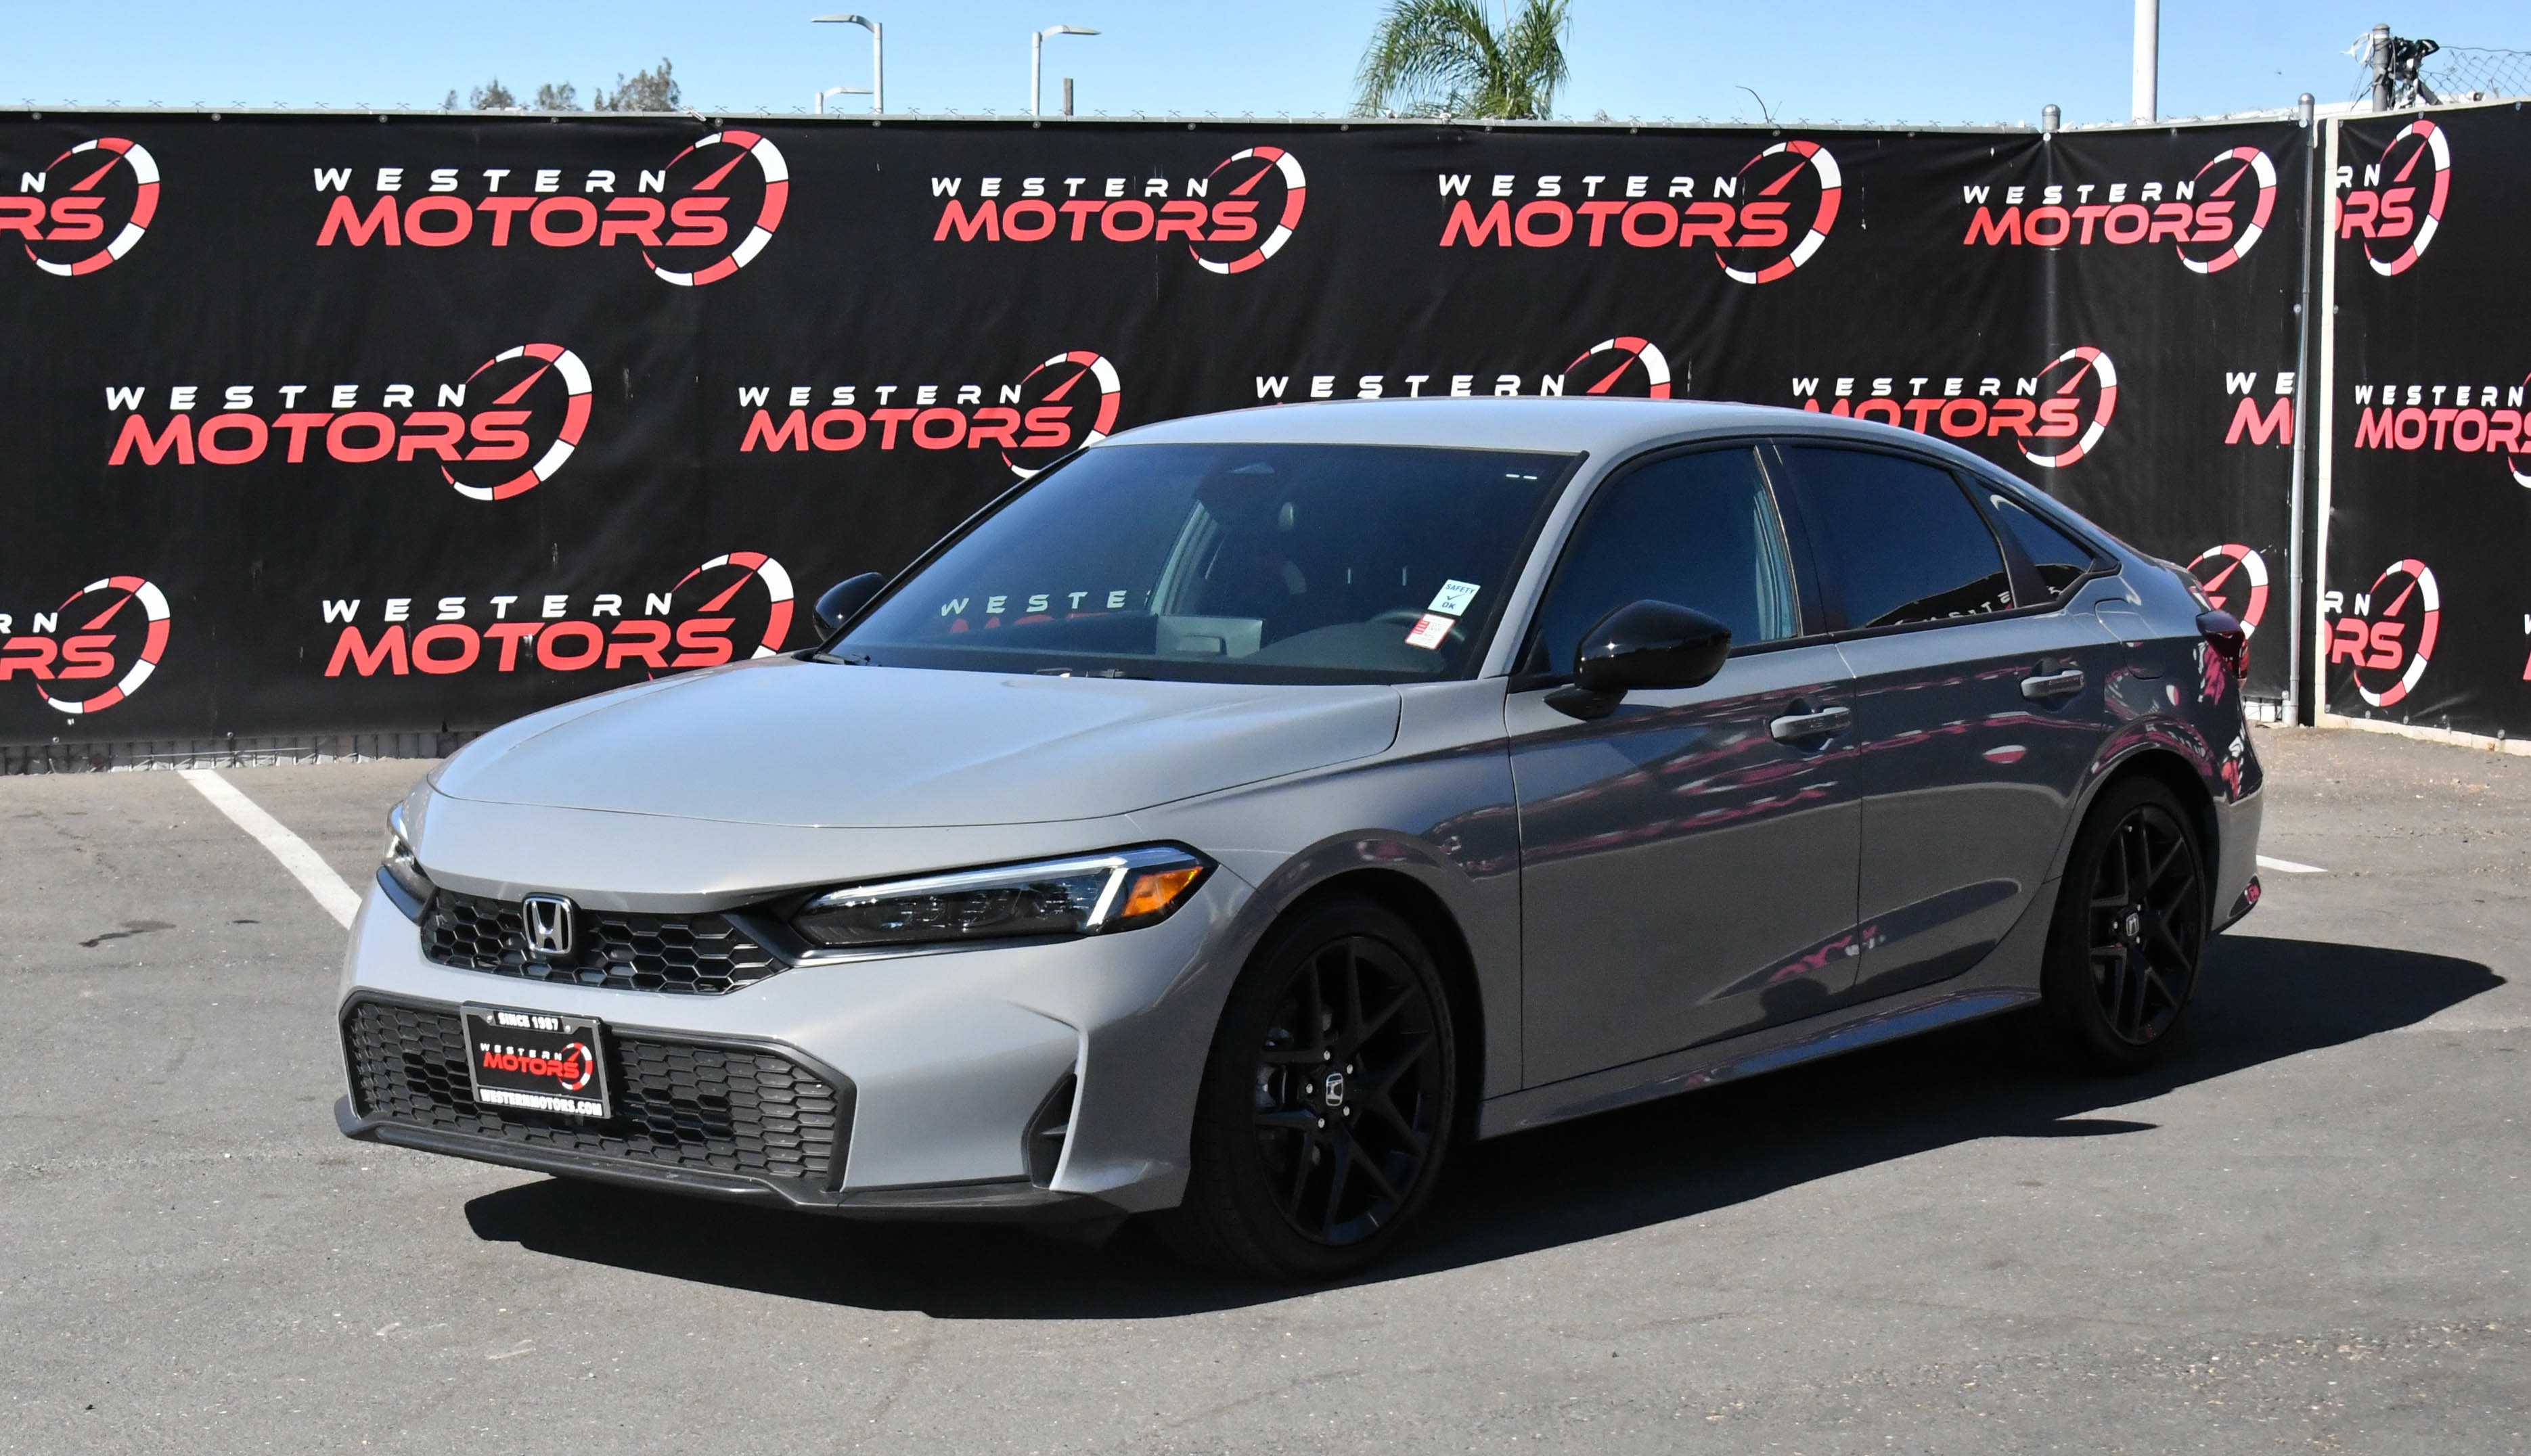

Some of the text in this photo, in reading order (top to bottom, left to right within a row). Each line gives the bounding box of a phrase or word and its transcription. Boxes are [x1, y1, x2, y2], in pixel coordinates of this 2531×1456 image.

[313, 167, 666, 193] WESTERN
[931, 177, 1209, 198] WESTERN
[1439, 174, 1737, 198] WESTERN
[1963, 180, 2195, 204] WESTERN
[316, 195, 731, 248] MOTORS
[933, 199, 1260, 242] MOTORS
[1439, 200, 1791, 248] MOTORS
[1963, 200, 2236, 246] MOTORS
[106, 384, 466, 411] WESTERN
[738, 384, 1022, 407] WESTERN
[1255, 375, 1565, 398] WESTERN
[1792, 377, 2038, 396] WESTERN
[2355, 384, 2524, 407] WESTERN
[108, 410, 532, 465] MOTORS
[740, 407, 1073, 453] MOTORS
[1446, 583, 1475, 595] SAFETY
[322, 591, 672, 623] WESTERN
[1441, 601, 1456, 610] OK
[324, 617, 736, 677] MOTORS
[498, 1012, 531, 1028] SINCE
[480, 1043, 562, 1061] WESTERN
[483, 1051, 580, 1079] MOTORS
[480, 1089, 603, 1116] WESTERNMOTORS.COM
